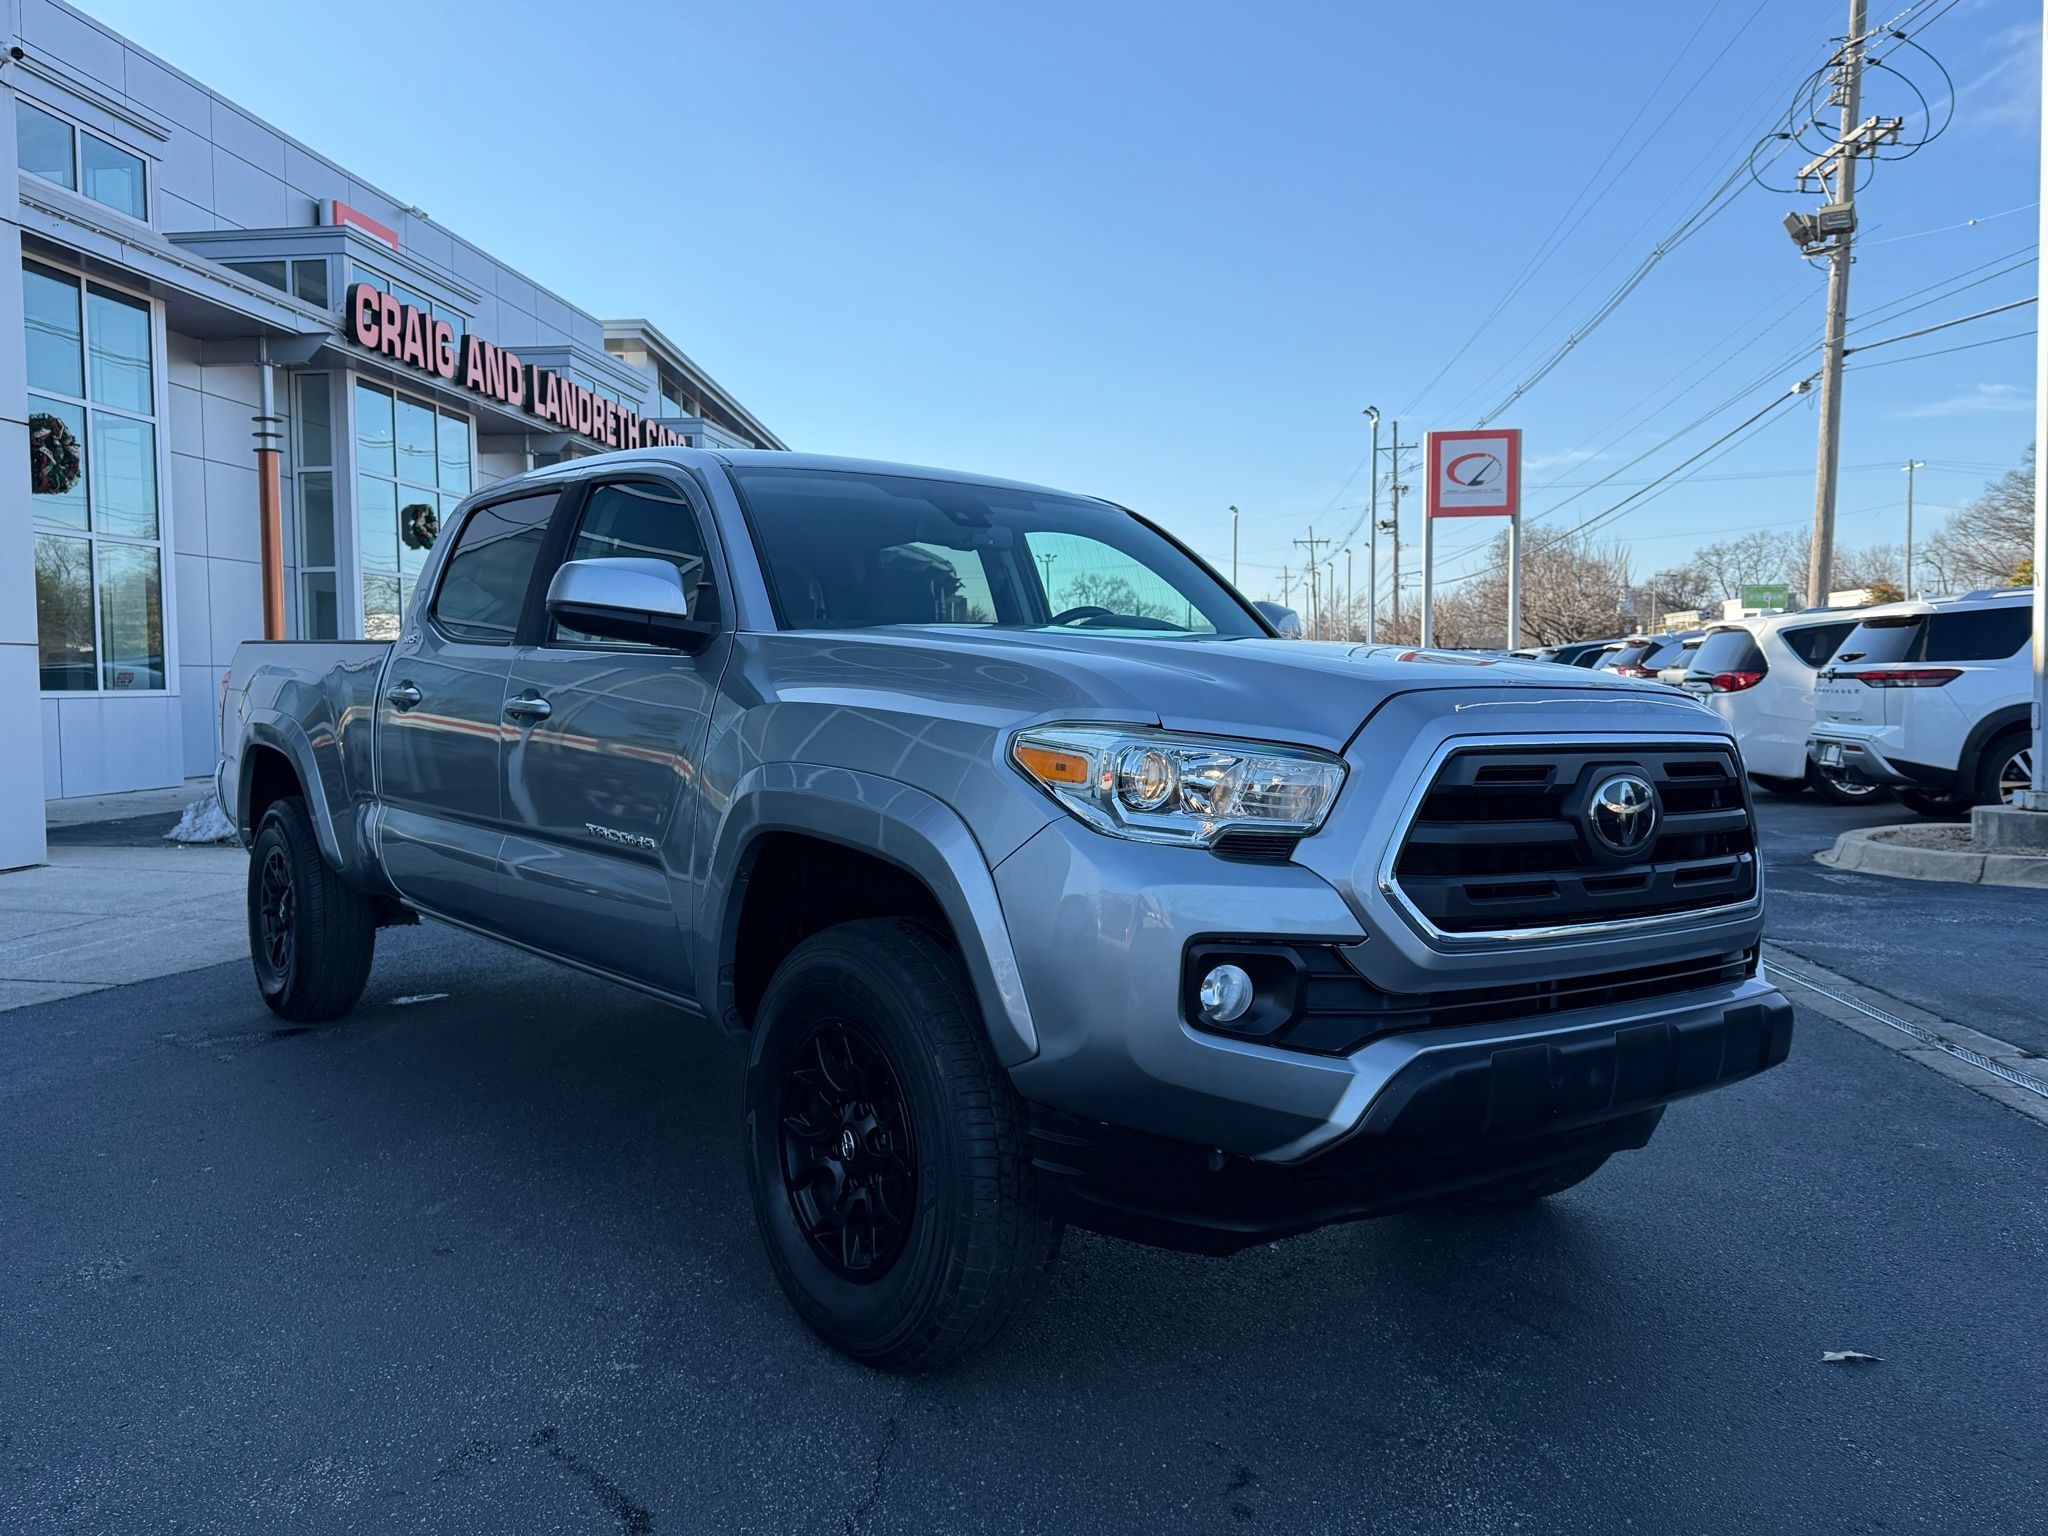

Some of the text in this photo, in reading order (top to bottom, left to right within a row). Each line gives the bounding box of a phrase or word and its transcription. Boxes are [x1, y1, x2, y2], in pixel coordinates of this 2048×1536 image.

[347, 282, 455, 379] CRAIG
[460, 334, 524, 407] AND
[525, 364, 640, 449] LANDRETH
[585, 822, 656, 849] TACOMA
